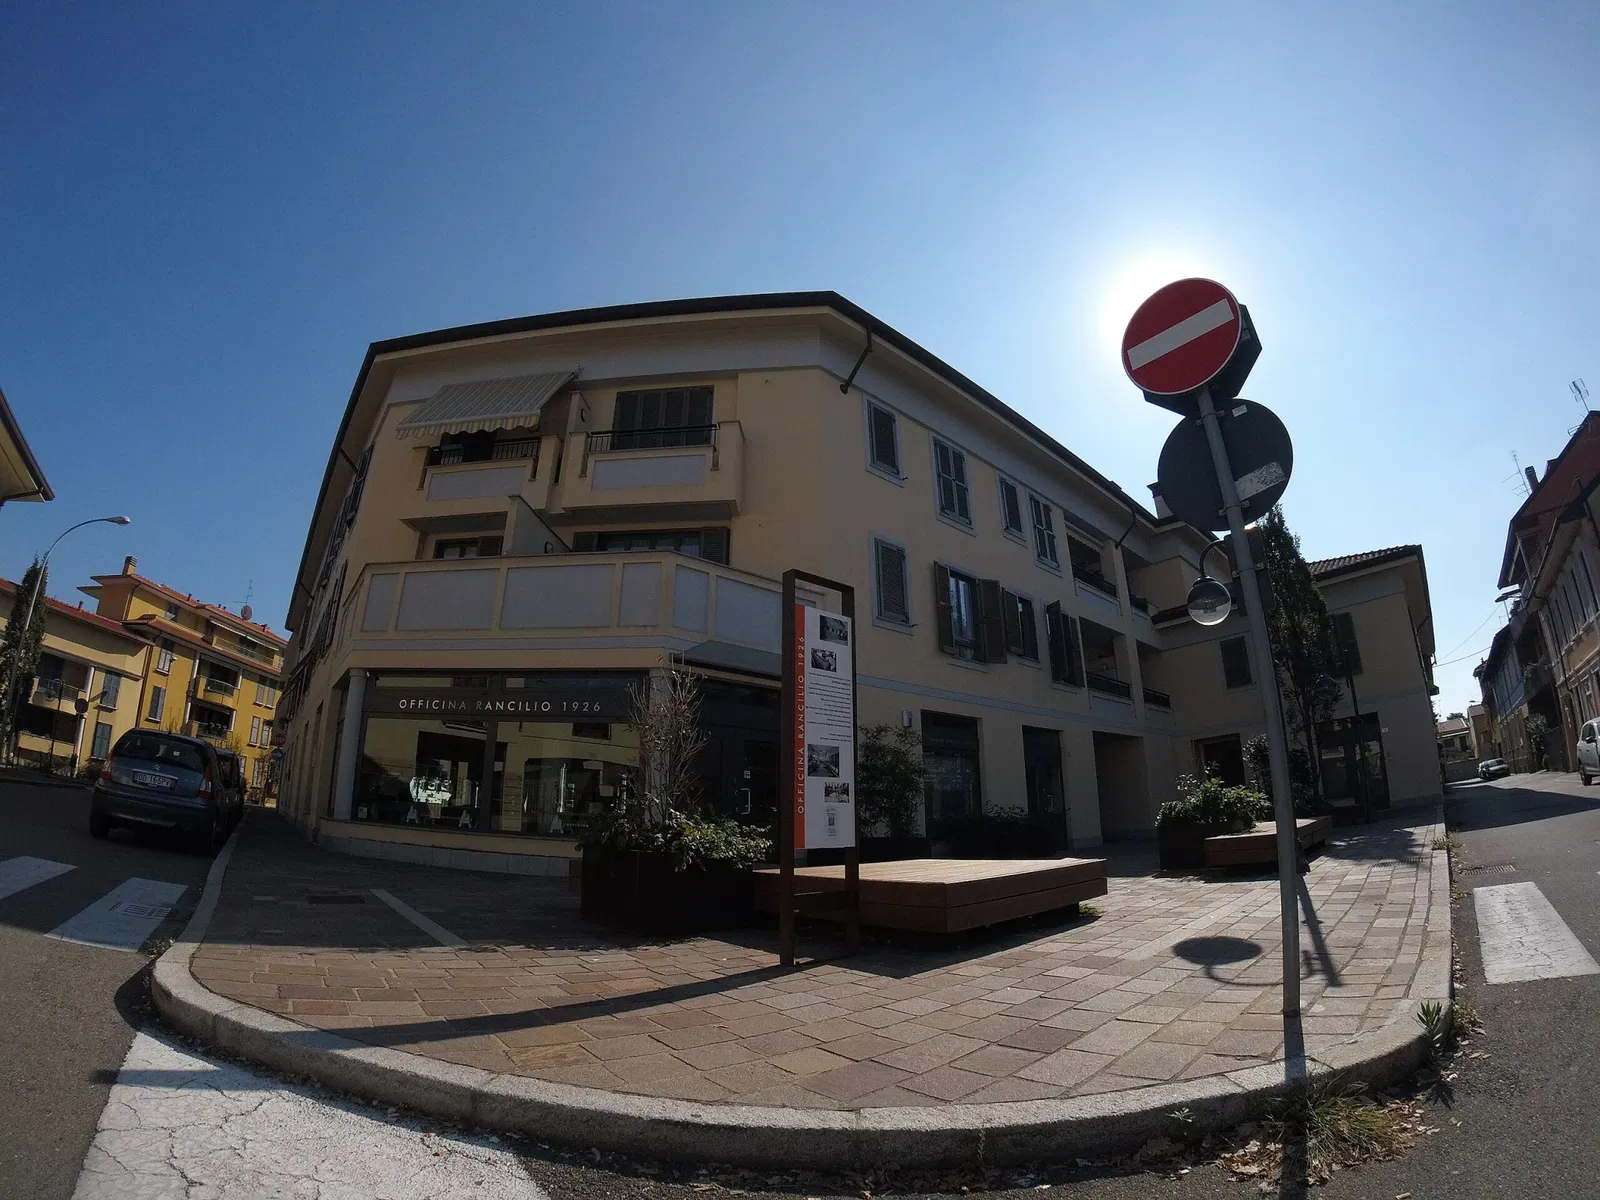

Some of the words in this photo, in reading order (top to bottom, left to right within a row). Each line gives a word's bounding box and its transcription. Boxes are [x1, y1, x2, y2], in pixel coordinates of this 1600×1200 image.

[399, 699, 466, 710] OFFICINA
[476, 700, 551, 711] RANCILIO
[562, 701, 600, 711] 1926
